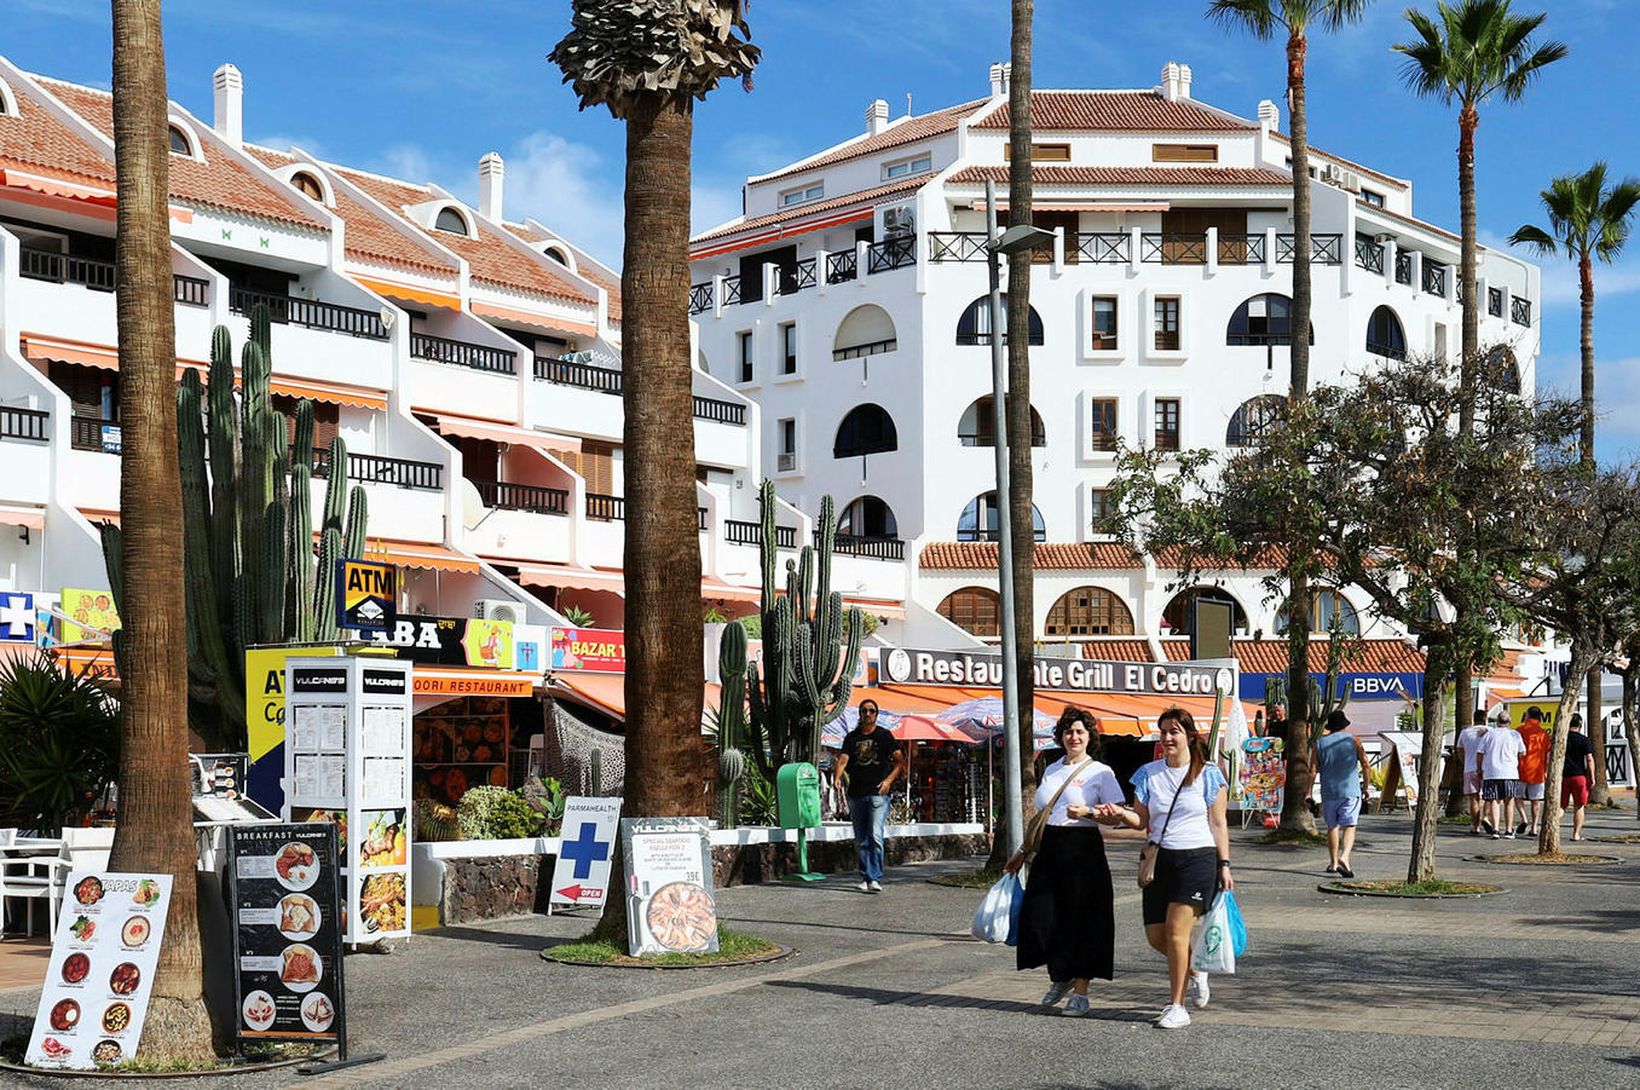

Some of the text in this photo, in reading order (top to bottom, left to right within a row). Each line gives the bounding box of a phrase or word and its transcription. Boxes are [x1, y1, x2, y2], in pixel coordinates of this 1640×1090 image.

[348, 568, 392, 595] ATM
[571, 641, 616, 657] BAZAR
[916, 653, 1212, 694] Restaute Grill El Cedro
[450, 681, 524, 693] RESTAURANT
[1353, 677, 1405, 693] BBVA
[236, 832, 292, 840] BREAKFAST
[101, 879, 138, 892] TAPAS
[581, 889, 601, 897] OPEN
